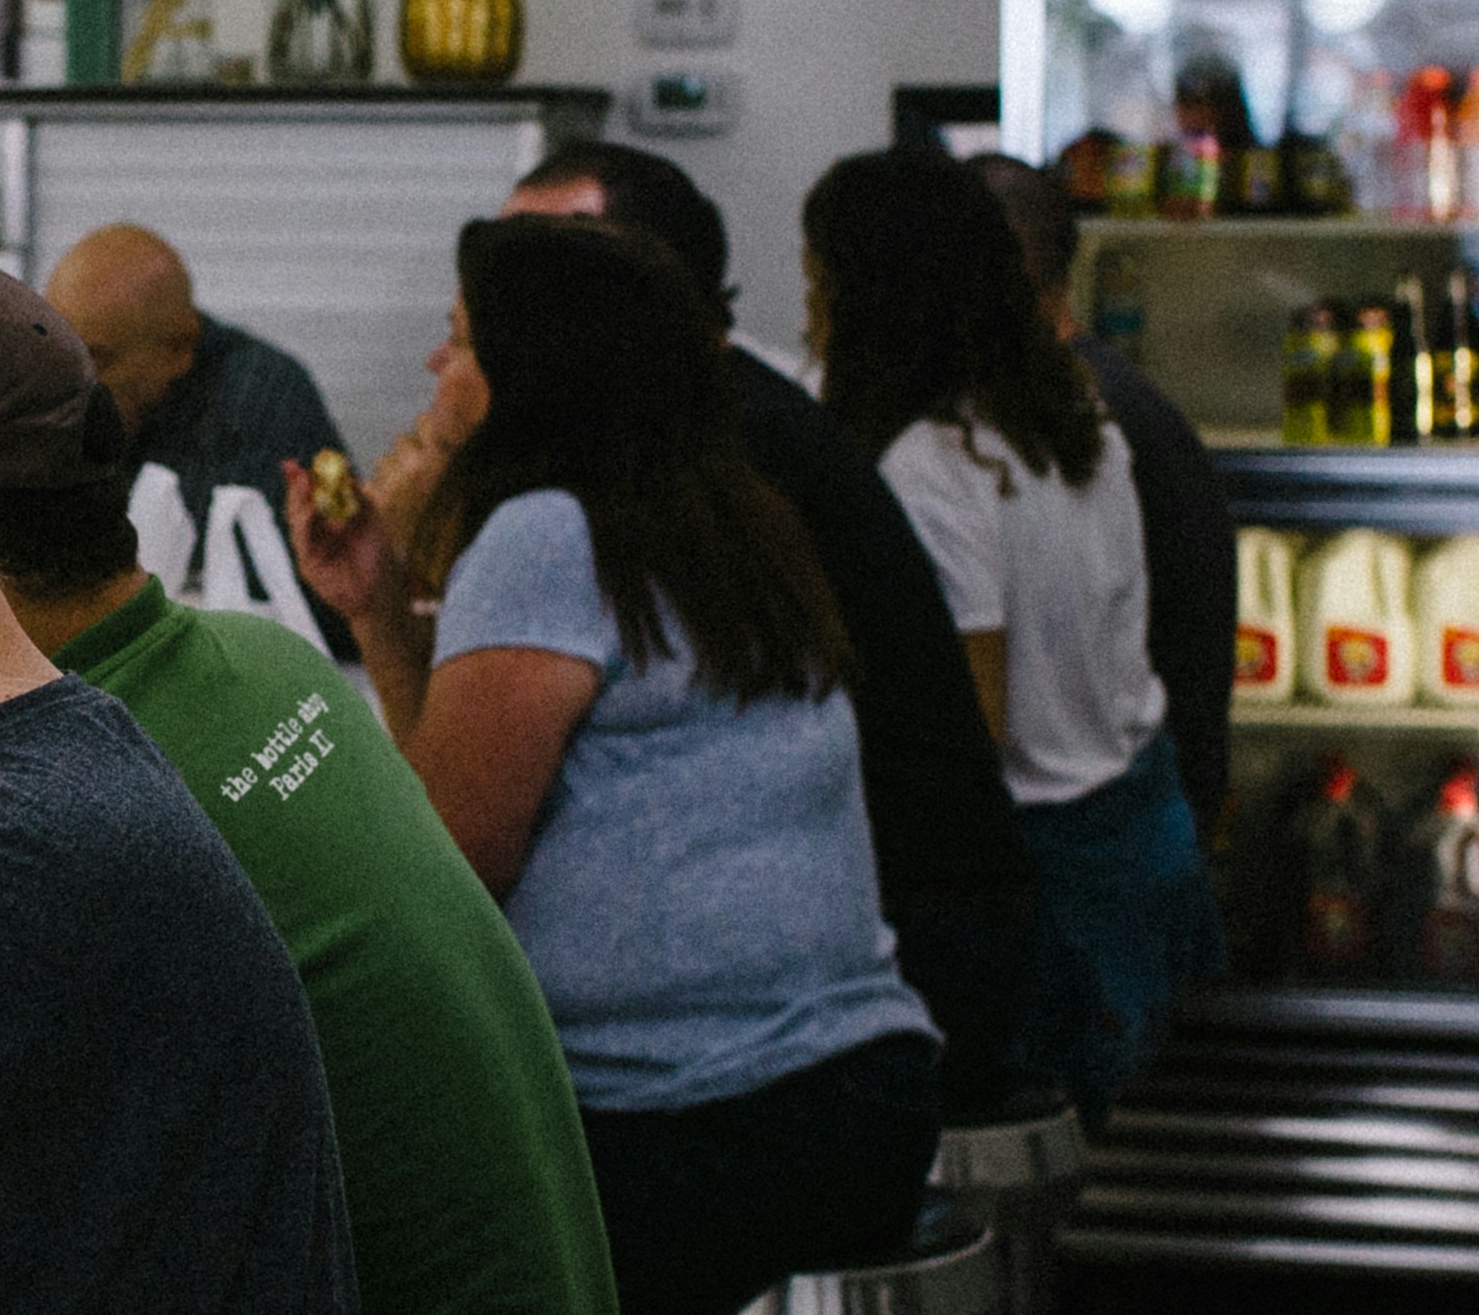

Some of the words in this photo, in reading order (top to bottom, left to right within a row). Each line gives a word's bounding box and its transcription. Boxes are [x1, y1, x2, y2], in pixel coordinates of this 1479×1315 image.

[220, 767, 259, 802] the
[250, 717, 303, 771] bottle
[297, 692, 330, 724] shop
[269, 751, 319, 801] Paris
